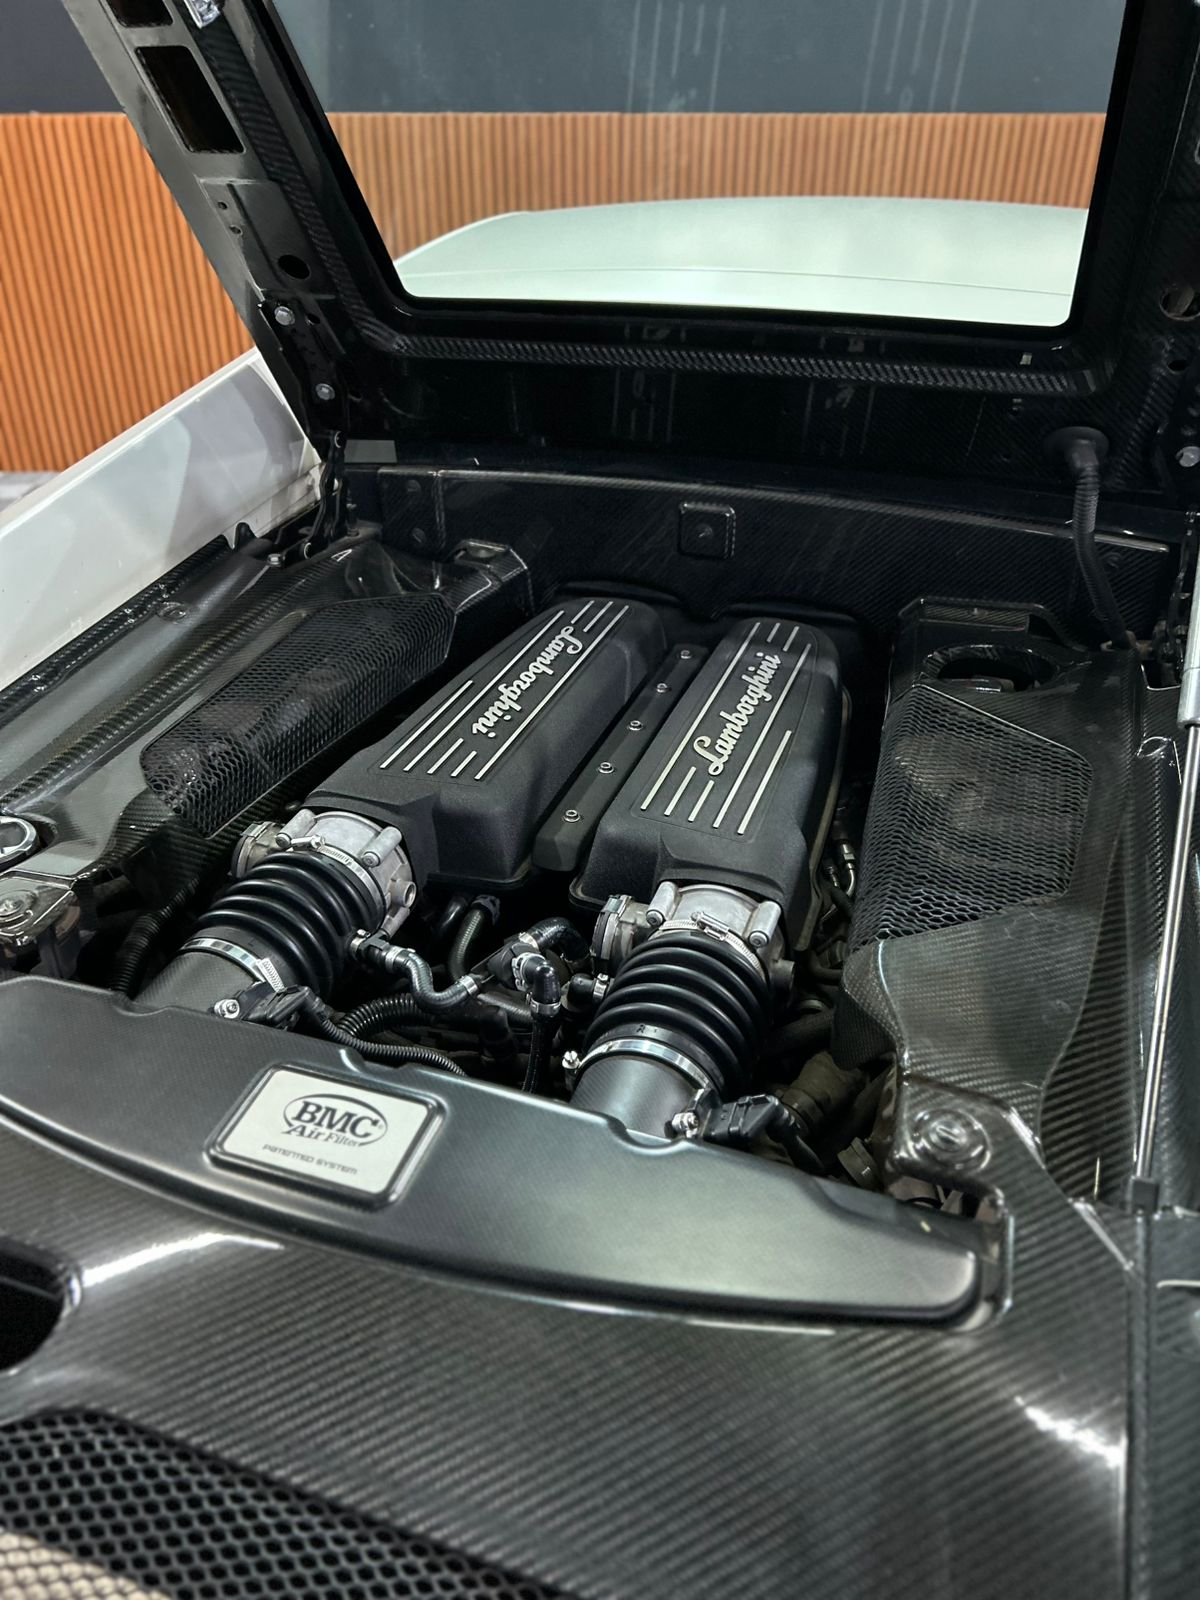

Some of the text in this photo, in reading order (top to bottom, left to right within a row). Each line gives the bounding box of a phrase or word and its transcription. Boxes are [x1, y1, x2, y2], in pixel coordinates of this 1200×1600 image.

[472, 626, 583, 738] Lamborghini
[693, 651, 782, 776] Lamborghini
[281, 1124, 361, 1148] Air Filter
[292, 1101, 378, 1138] BMC
